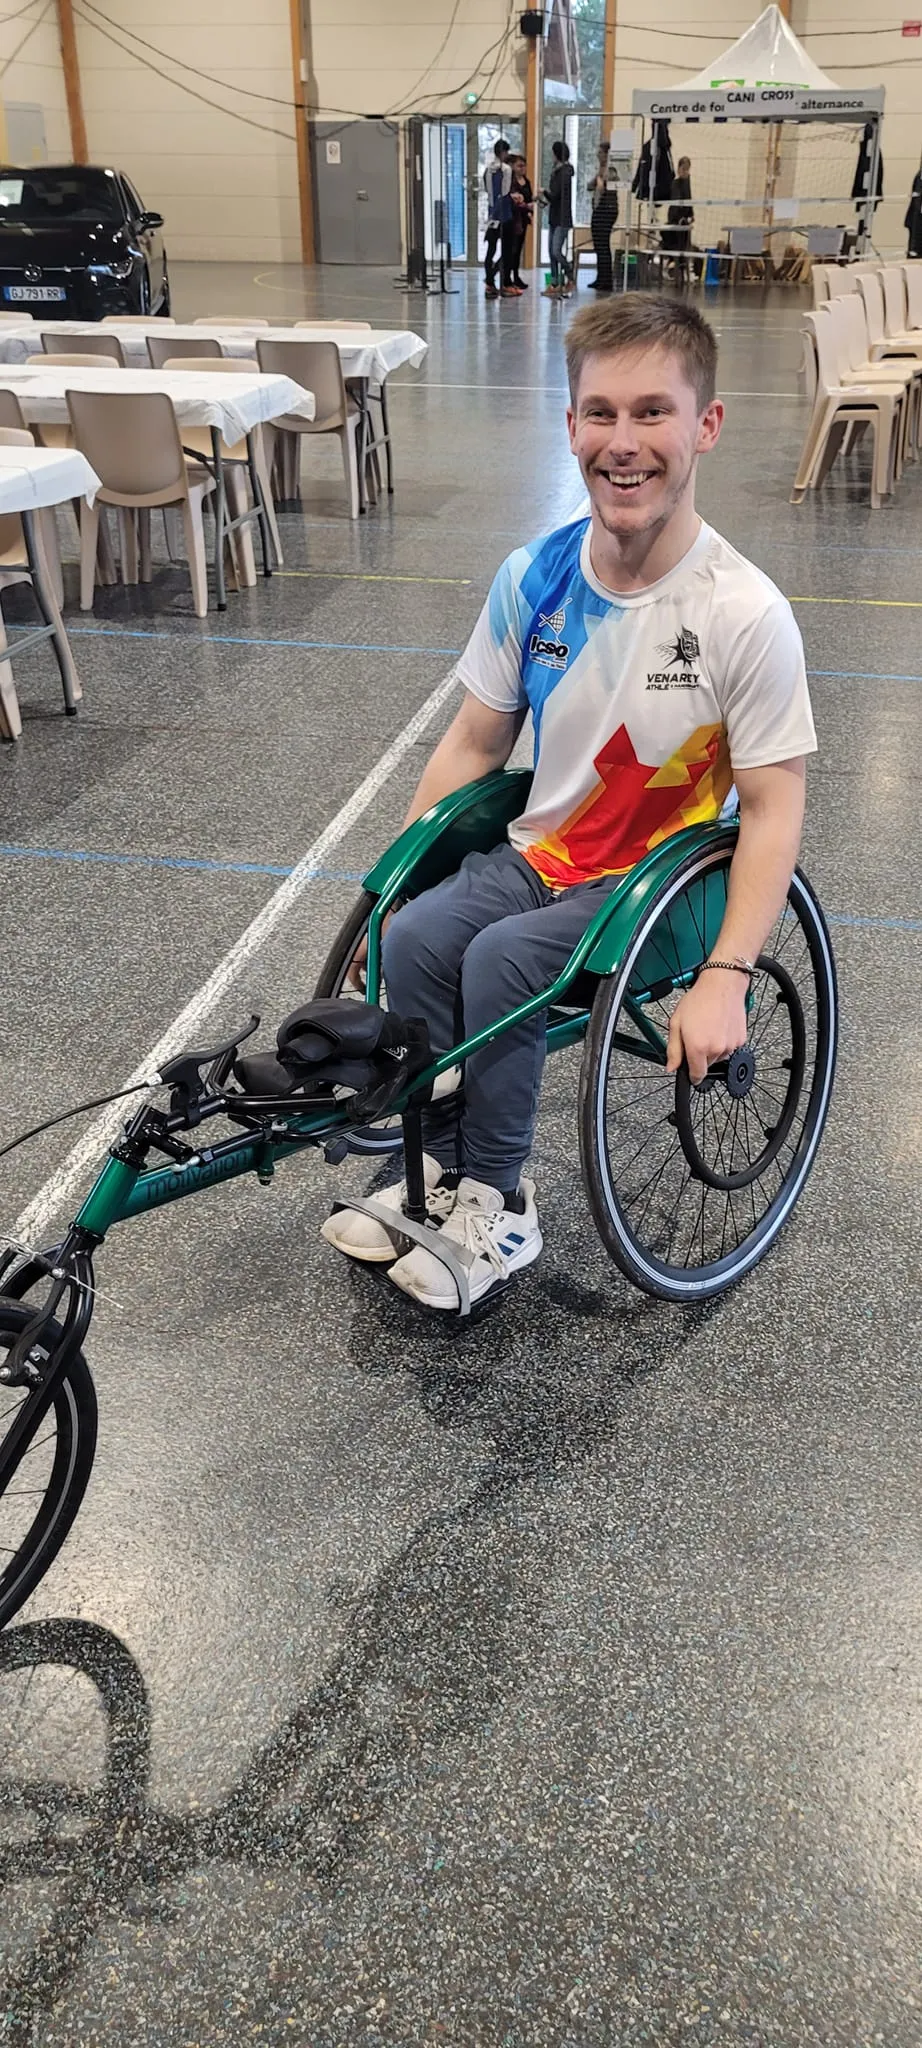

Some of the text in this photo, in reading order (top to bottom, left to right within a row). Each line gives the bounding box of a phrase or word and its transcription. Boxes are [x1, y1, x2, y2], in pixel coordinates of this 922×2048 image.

[727, 91, 794, 102] CANI CROSS
[650, 103, 689, 114] Centre
[691, 101, 706, 112] de
[801, 99, 864, 109] alternance
[26, 288, 44, 299] 791
[647, 673, 701, 683] VENAREY
[146, 1147, 253, 1200] motivation
